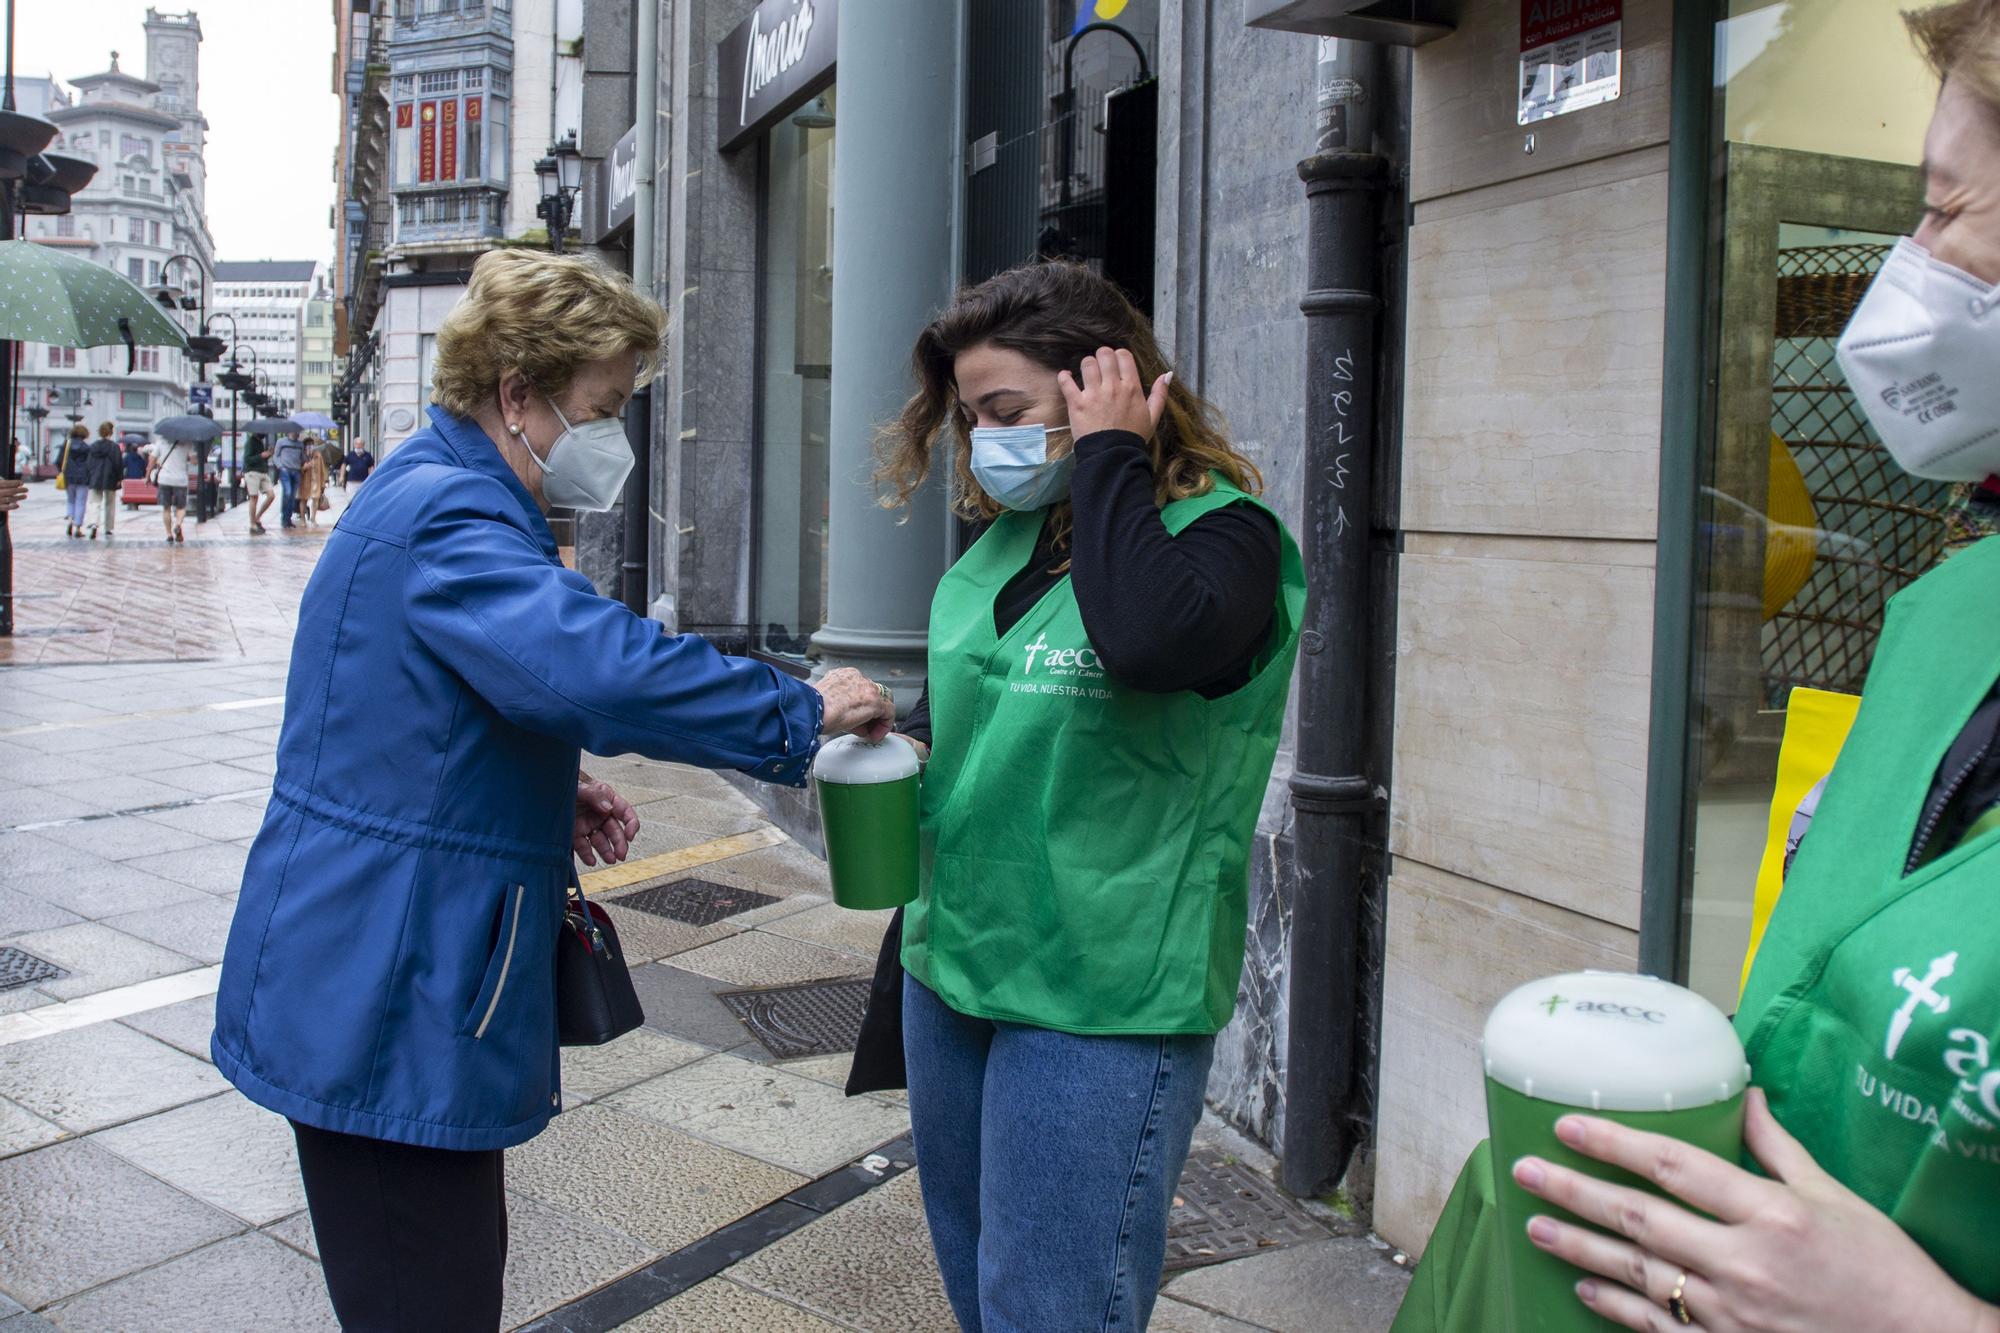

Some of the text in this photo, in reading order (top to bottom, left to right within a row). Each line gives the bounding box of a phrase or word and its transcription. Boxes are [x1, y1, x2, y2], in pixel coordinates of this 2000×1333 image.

[1009, 682, 1020, 693] TU
[1040, 684, 1086, 697] NUESTRA
[1088, 688, 1113, 700] VIDA
[1575, 1000, 1667, 1025] aecc
